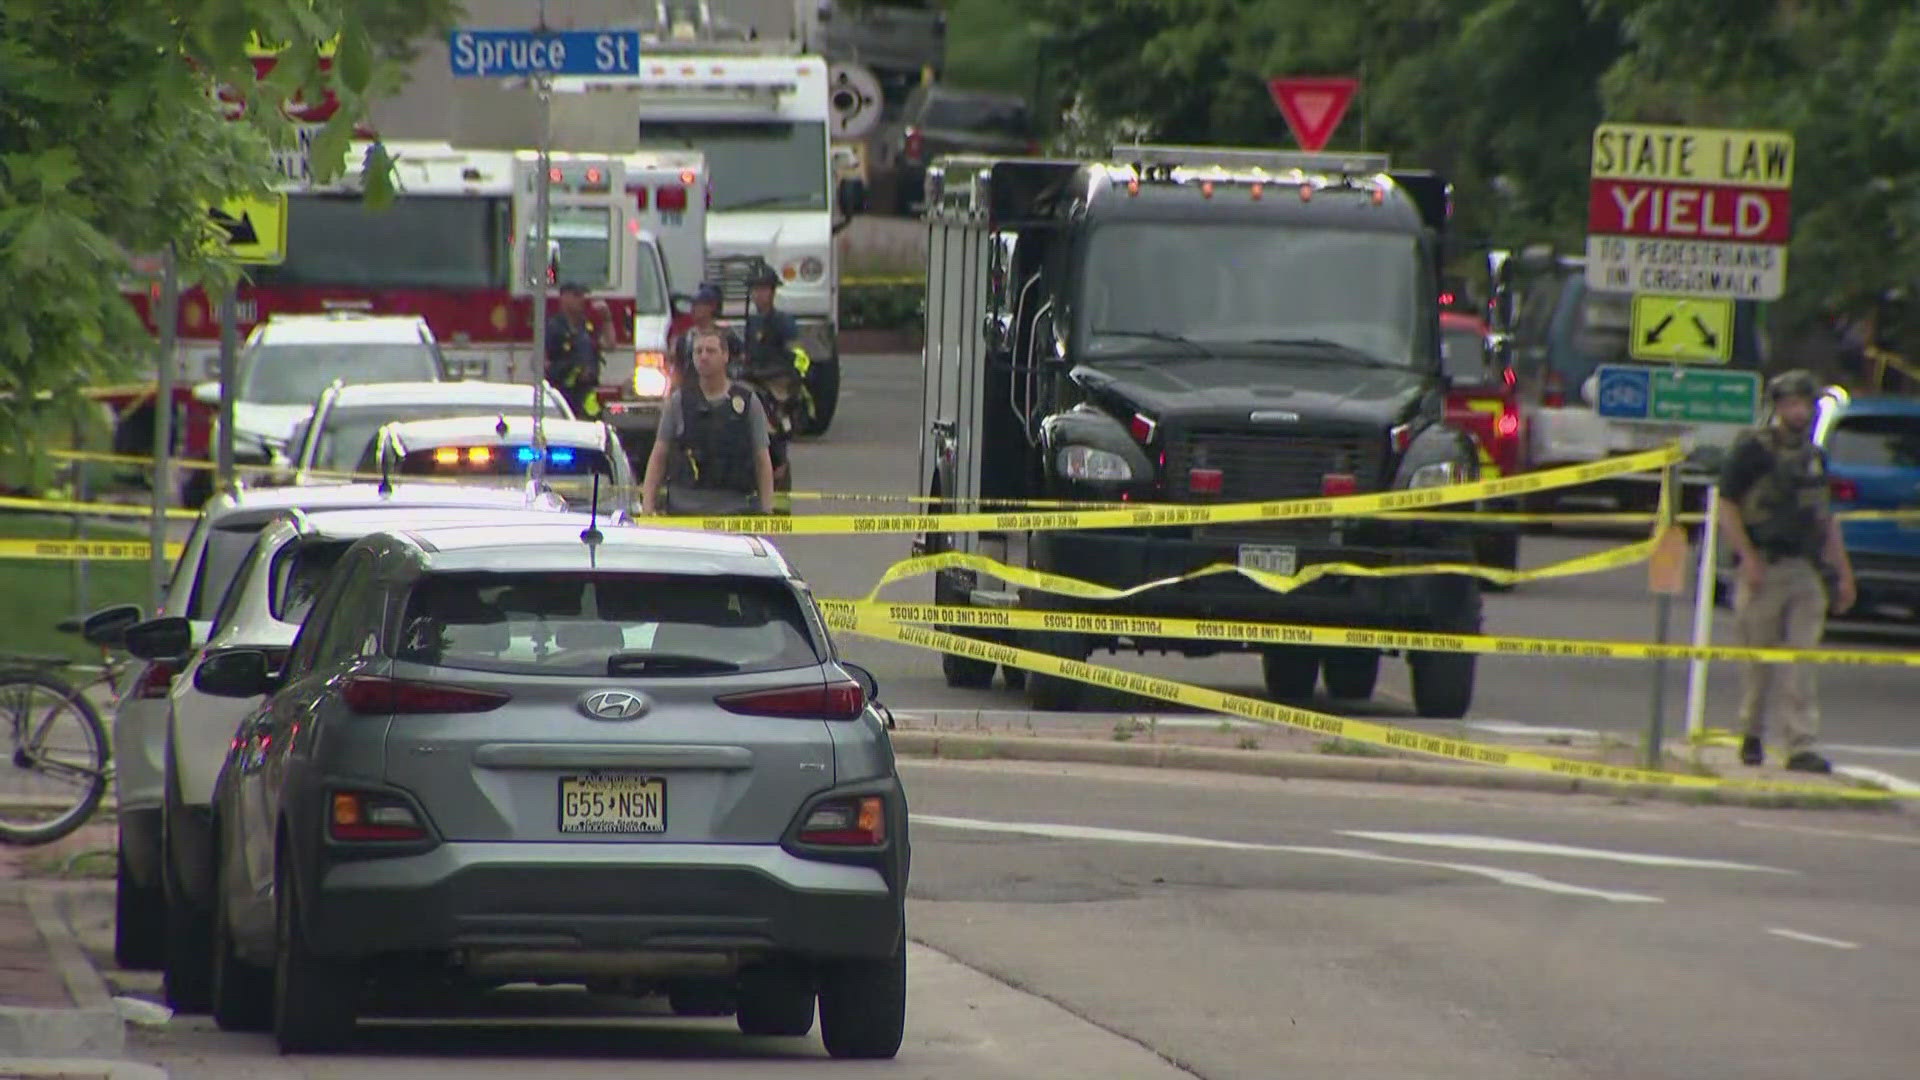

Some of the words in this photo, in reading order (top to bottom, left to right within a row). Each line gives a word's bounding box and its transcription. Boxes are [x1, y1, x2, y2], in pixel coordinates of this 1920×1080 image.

[455, 33, 567, 76] Spruce
[595, 34, 629, 71] St
[1595, 131, 1695, 177] STATE
[1722, 136, 1788, 180] LAW
[1611, 184, 1771, 238] YIELD
[1602, 240, 1627, 260] TO
[1636, 240, 1776, 269] PEDESTRIANS
[1607, 267, 1630, 284] IN
[890, 607, 919, 620] CROSS
[923, 607, 939, 621] NOT
[942, 608, 953, 622] DO
[957, 609, 975, 624] LINE
[979, 611, 1009, 625] POLICE
[1044, 615, 1072, 628] CROSS
[1076, 616, 1092, 630] NOT
[1095, 617, 1107, 631] DO
[1110, 618, 1128, 632] LINE
[1132, 620, 1162, 634] POLICE
[1195, 623, 1224, 637] CROSS
[1227, 624, 1243, 637] NOT
[1246, 626, 1257, 639] DO
[1261, 626, 1280, 640] LINE
[1282, 628, 1312, 642] POLICE
[566, 791, 604, 818] G55
[618, 791, 657, 818] NSN
